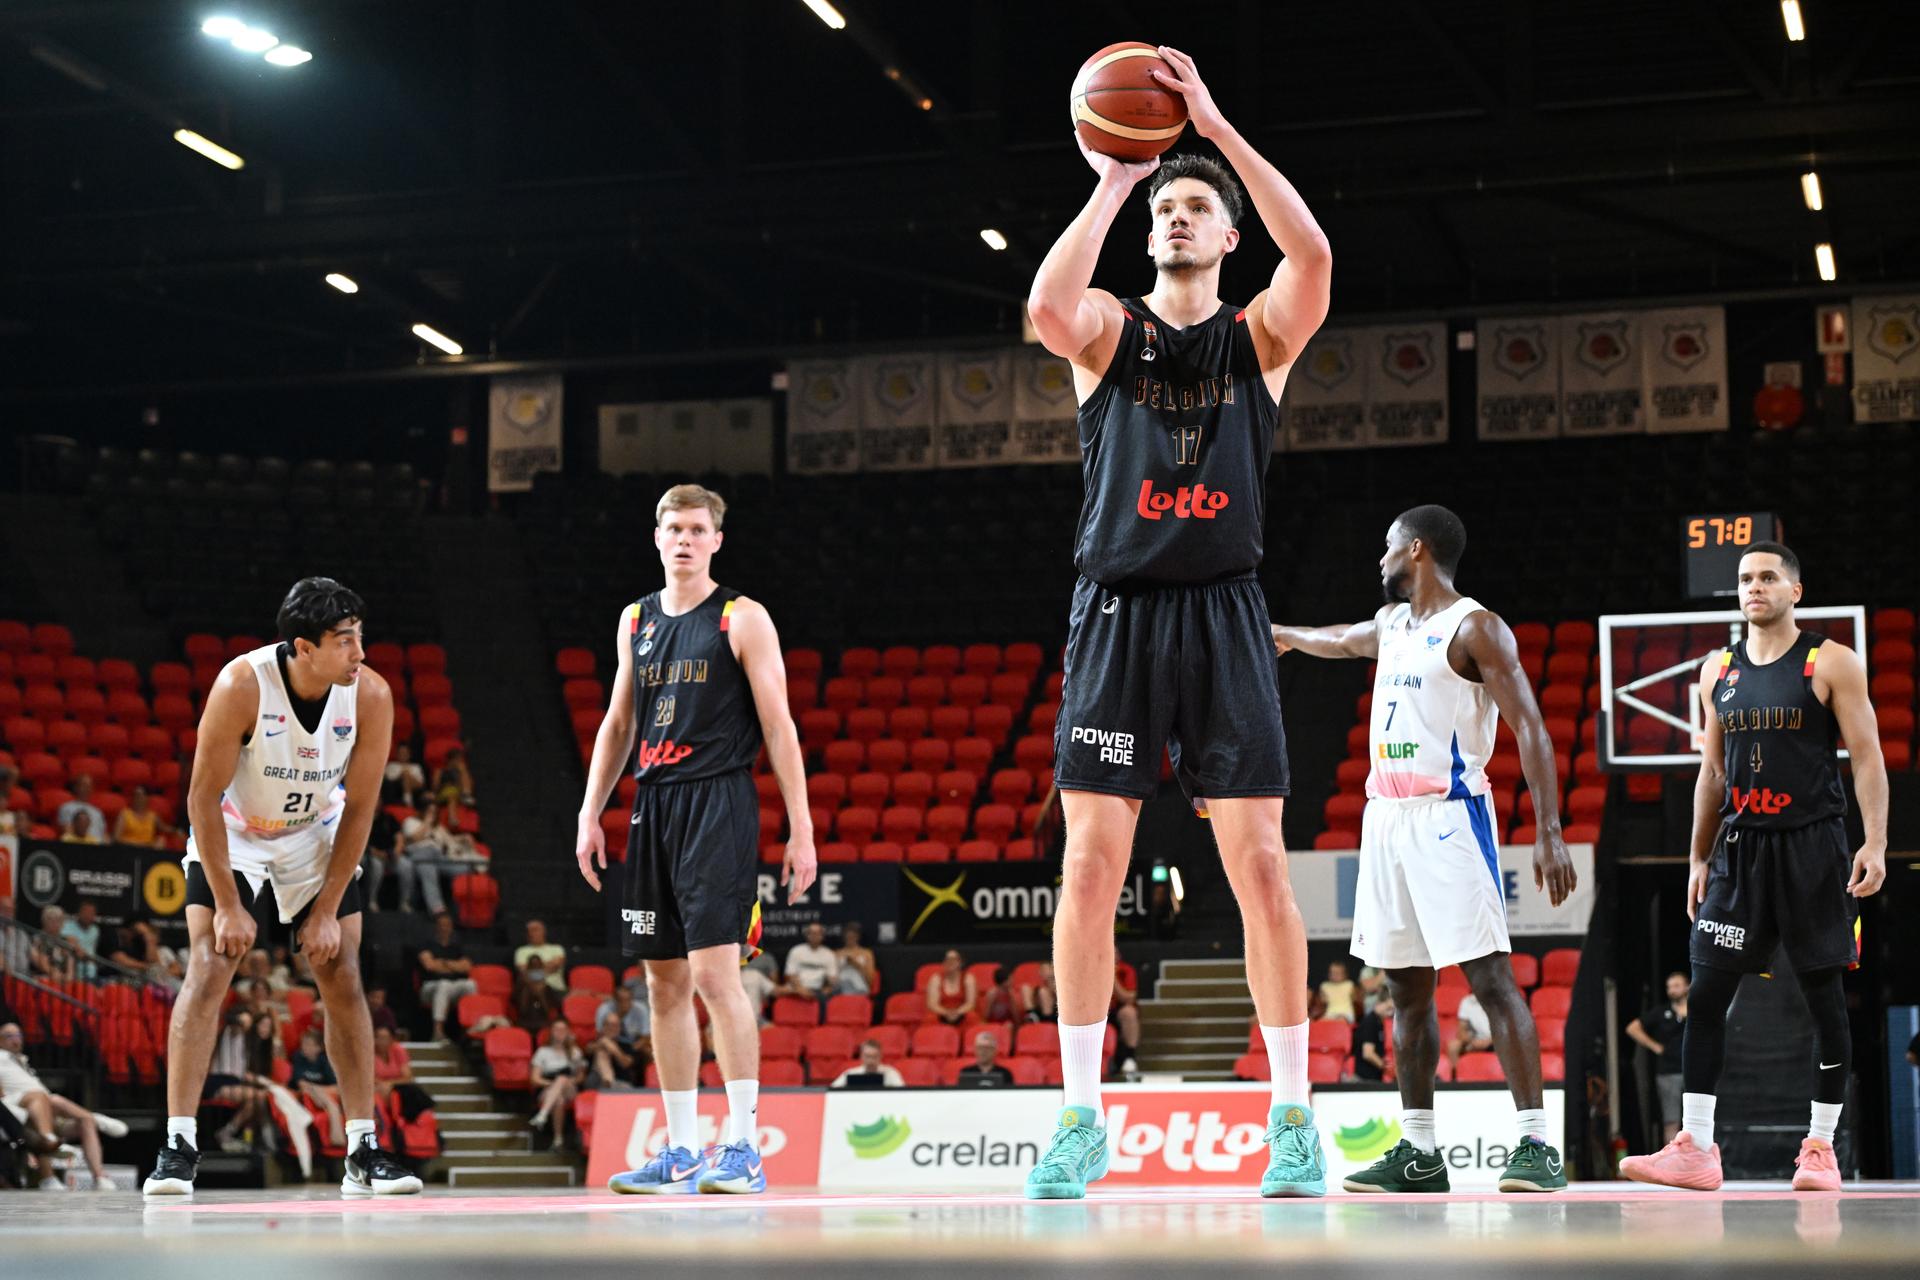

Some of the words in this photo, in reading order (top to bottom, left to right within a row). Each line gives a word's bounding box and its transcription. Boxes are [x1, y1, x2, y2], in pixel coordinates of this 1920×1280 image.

[1133, 373, 1236, 412] BELGIUM
[1171, 425, 1203, 465] 17
[1689, 517, 1752, 548] 57:8
[1385, 701, 1397, 731] 7
[1071, 727, 1135, 750] POWER
[1100, 746, 1134, 766] ADE
[1751, 743, 1763, 773] 4
[264, 765, 300, 780] GREAT
[283, 792, 314, 813] 21
[1697, 919, 1746, 940] POWER
[1713, 934, 1744, 951] ADE
[911, 1134, 1038, 1168] crelan
